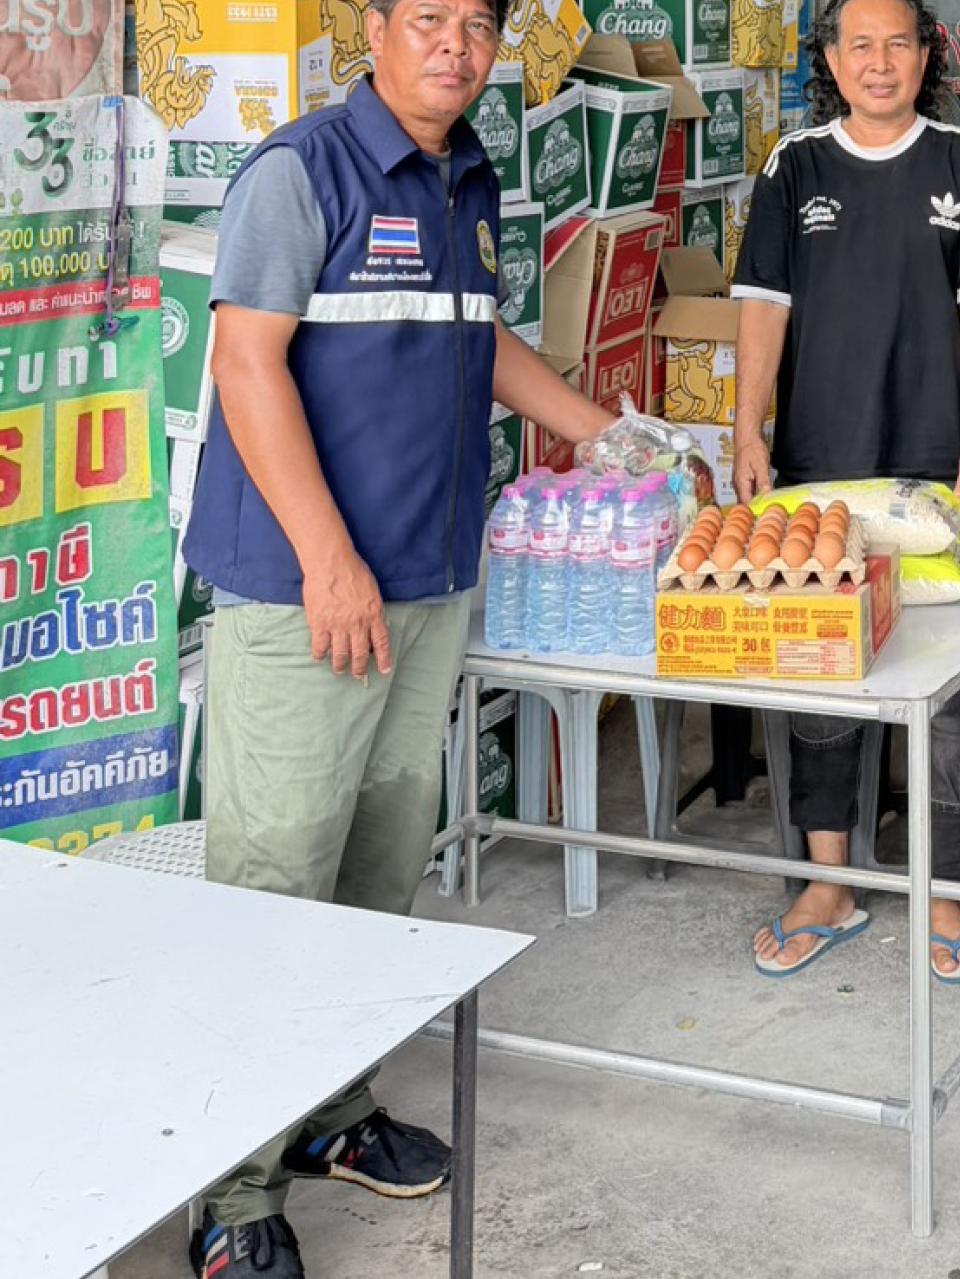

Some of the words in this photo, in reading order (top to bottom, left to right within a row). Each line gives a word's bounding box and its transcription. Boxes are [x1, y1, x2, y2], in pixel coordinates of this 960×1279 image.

[600, 12, 668, 39] Chang
[536, 147, 578, 183] Chang
[611, 286, 645, 318] LEO
[600, 362, 635, 395] LEO
[0, 746, 169, 808] ะกันอัคคีภัย
